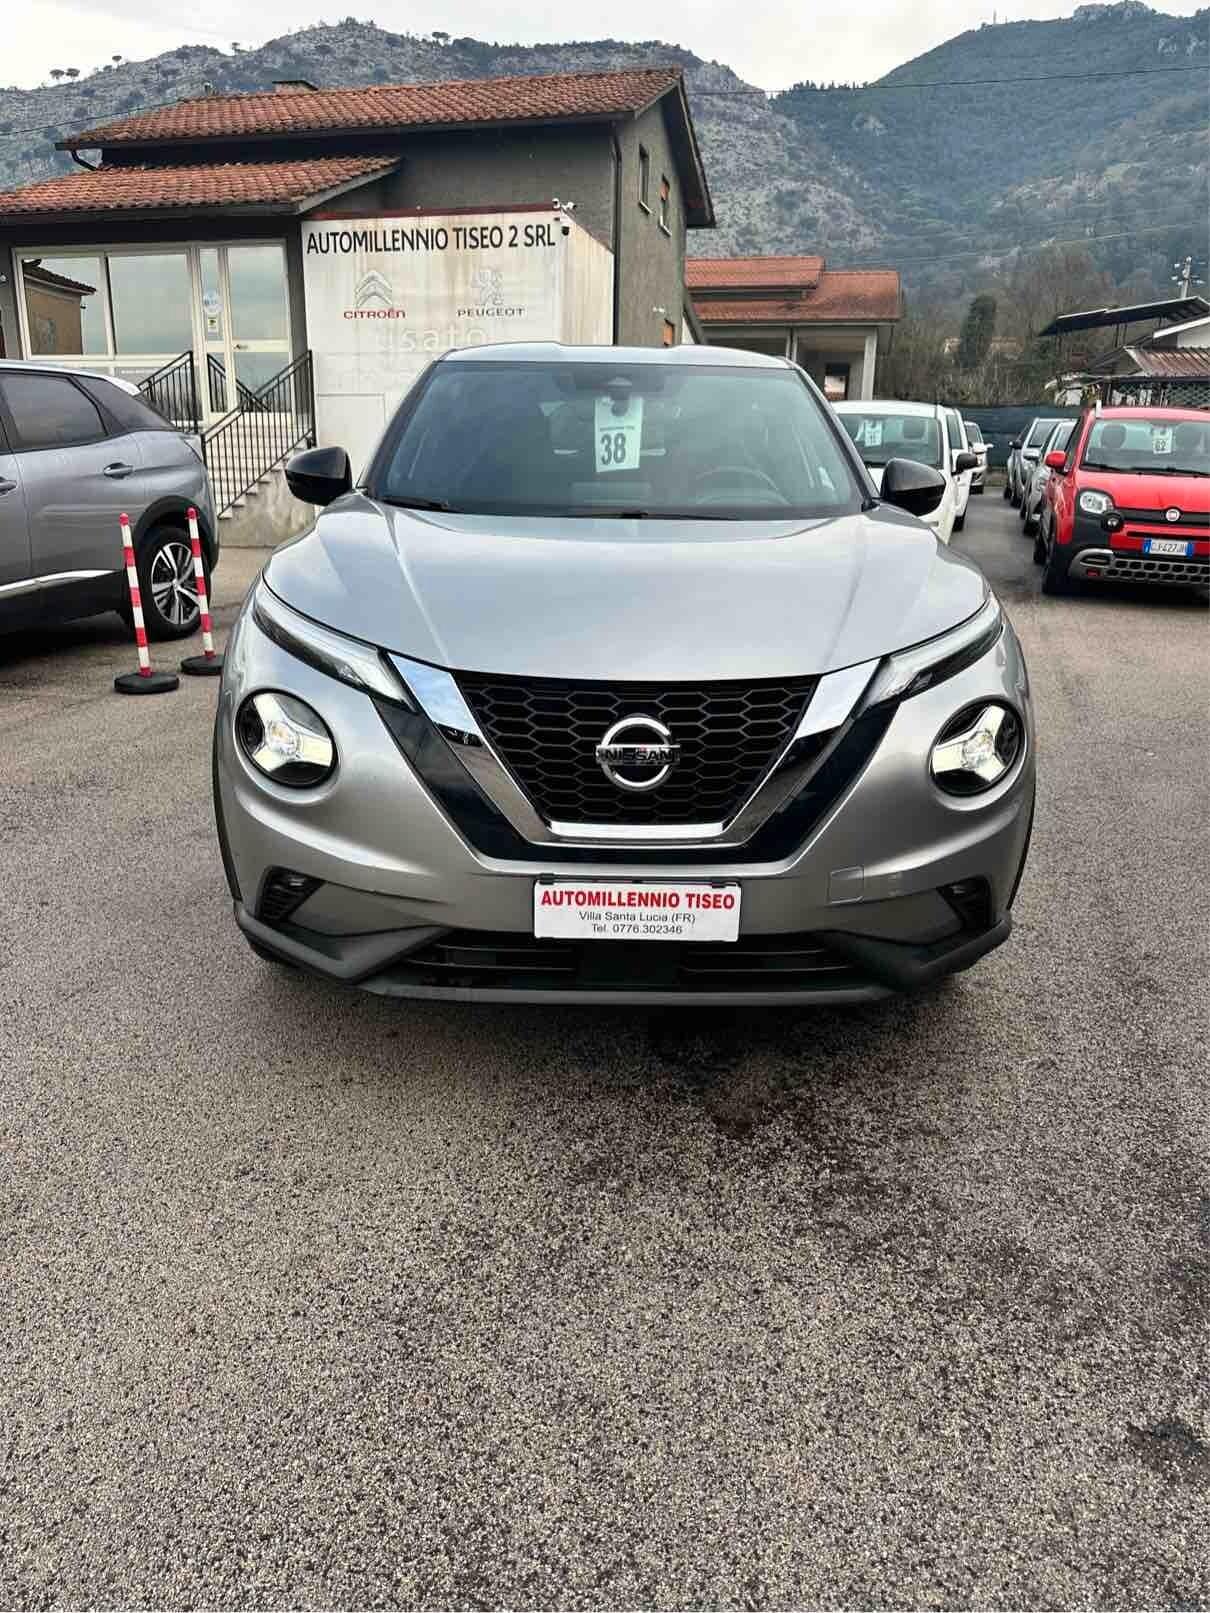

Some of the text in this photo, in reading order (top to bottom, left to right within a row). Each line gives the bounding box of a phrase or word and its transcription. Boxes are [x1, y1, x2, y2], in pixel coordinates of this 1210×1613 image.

[306, 223, 556, 254] AUTOMILLENNIO TISEO 2 SRL
[457, 307, 525, 318] PEUGEOT
[601, 433, 625, 465] 38
[604, 749, 675, 761] NISSAN
[540, 890, 735, 909] AUTOMILLENNIO TISEO
[579, 911, 696, 924] Villa Santa Lucia (FR)
